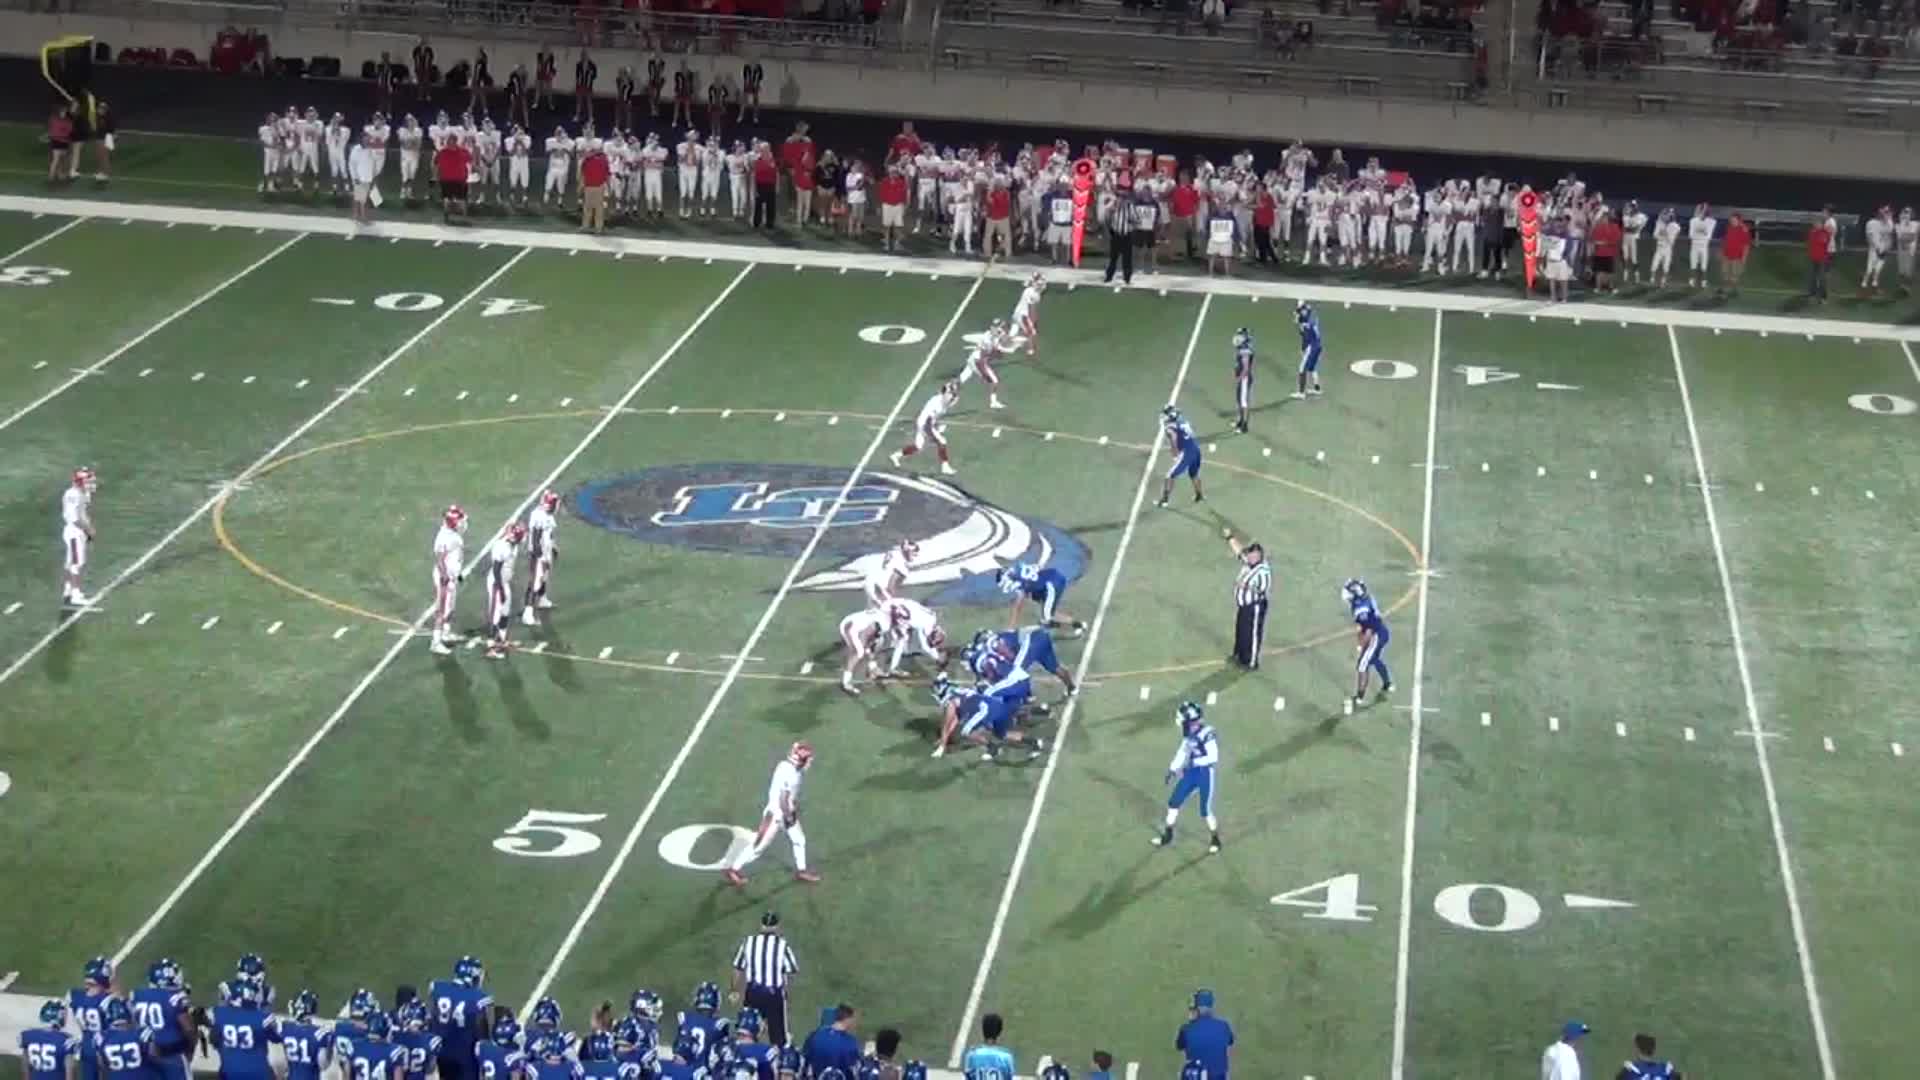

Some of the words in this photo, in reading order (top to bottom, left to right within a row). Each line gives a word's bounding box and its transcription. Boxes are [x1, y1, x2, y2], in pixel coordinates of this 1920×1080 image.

[651, 481, 899, 529] LC
[492, 809, 756, 871] 50
[1269, 873, 1543, 932] 40
[135, 1002, 164, 1029] 70
[437, 997, 465, 1028] 84
[223, 1024, 254, 1049] 93
[283, 1036, 311, 1063] 21
[27, 1043, 56, 1071] 65
[104, 1042, 142, 1070] 53
[354, 1056, 387, 1080] 34
